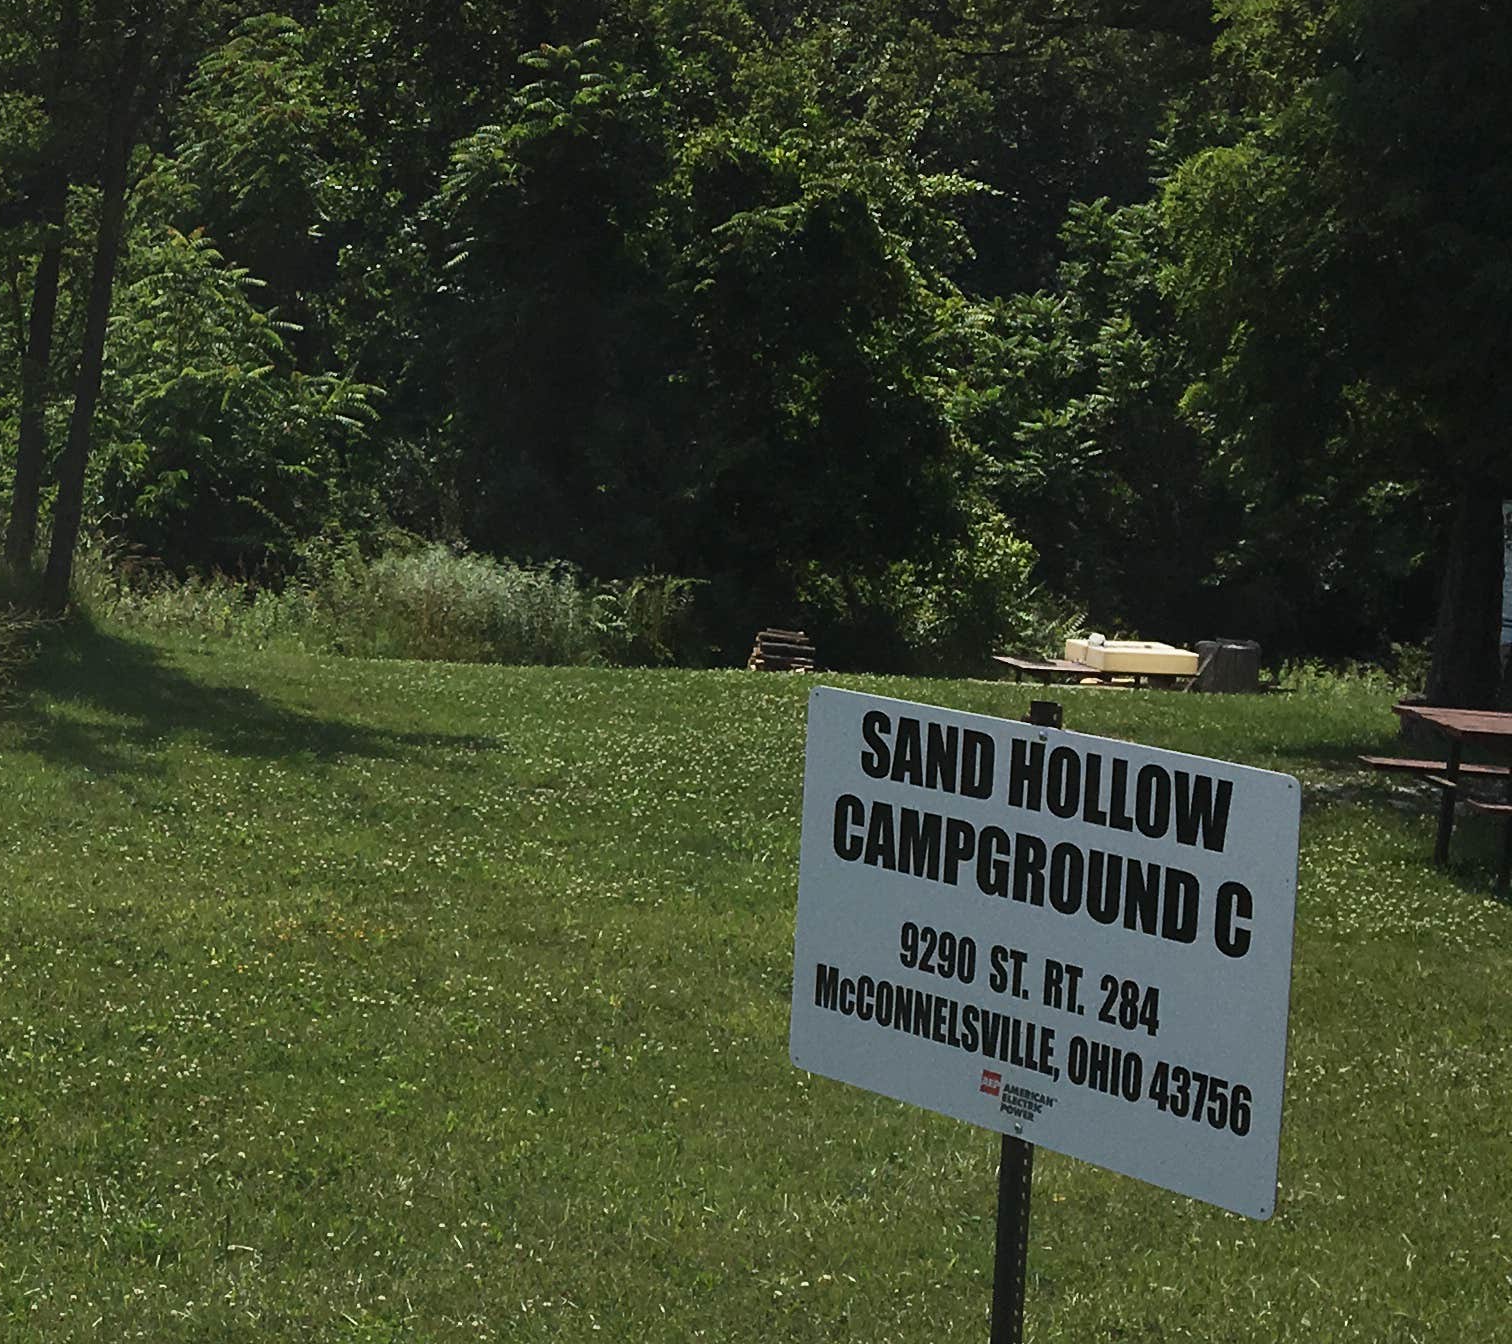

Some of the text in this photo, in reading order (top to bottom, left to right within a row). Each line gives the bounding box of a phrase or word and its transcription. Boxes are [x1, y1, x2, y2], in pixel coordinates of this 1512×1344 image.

[861, 709, 1233, 853] SAND HOLLOW
[833, 793, 1253, 958] CAMPGROUND C
[900, 921, 1160, 1036] 9290 ST. RT. 284
[814, 963, 1253, 1137] McCONNELSVILLE, OHIO 43756
[1000, 1103, 1034, 1121] POWER
[1002, 1094, 1043, 1113] ELECTRIC
